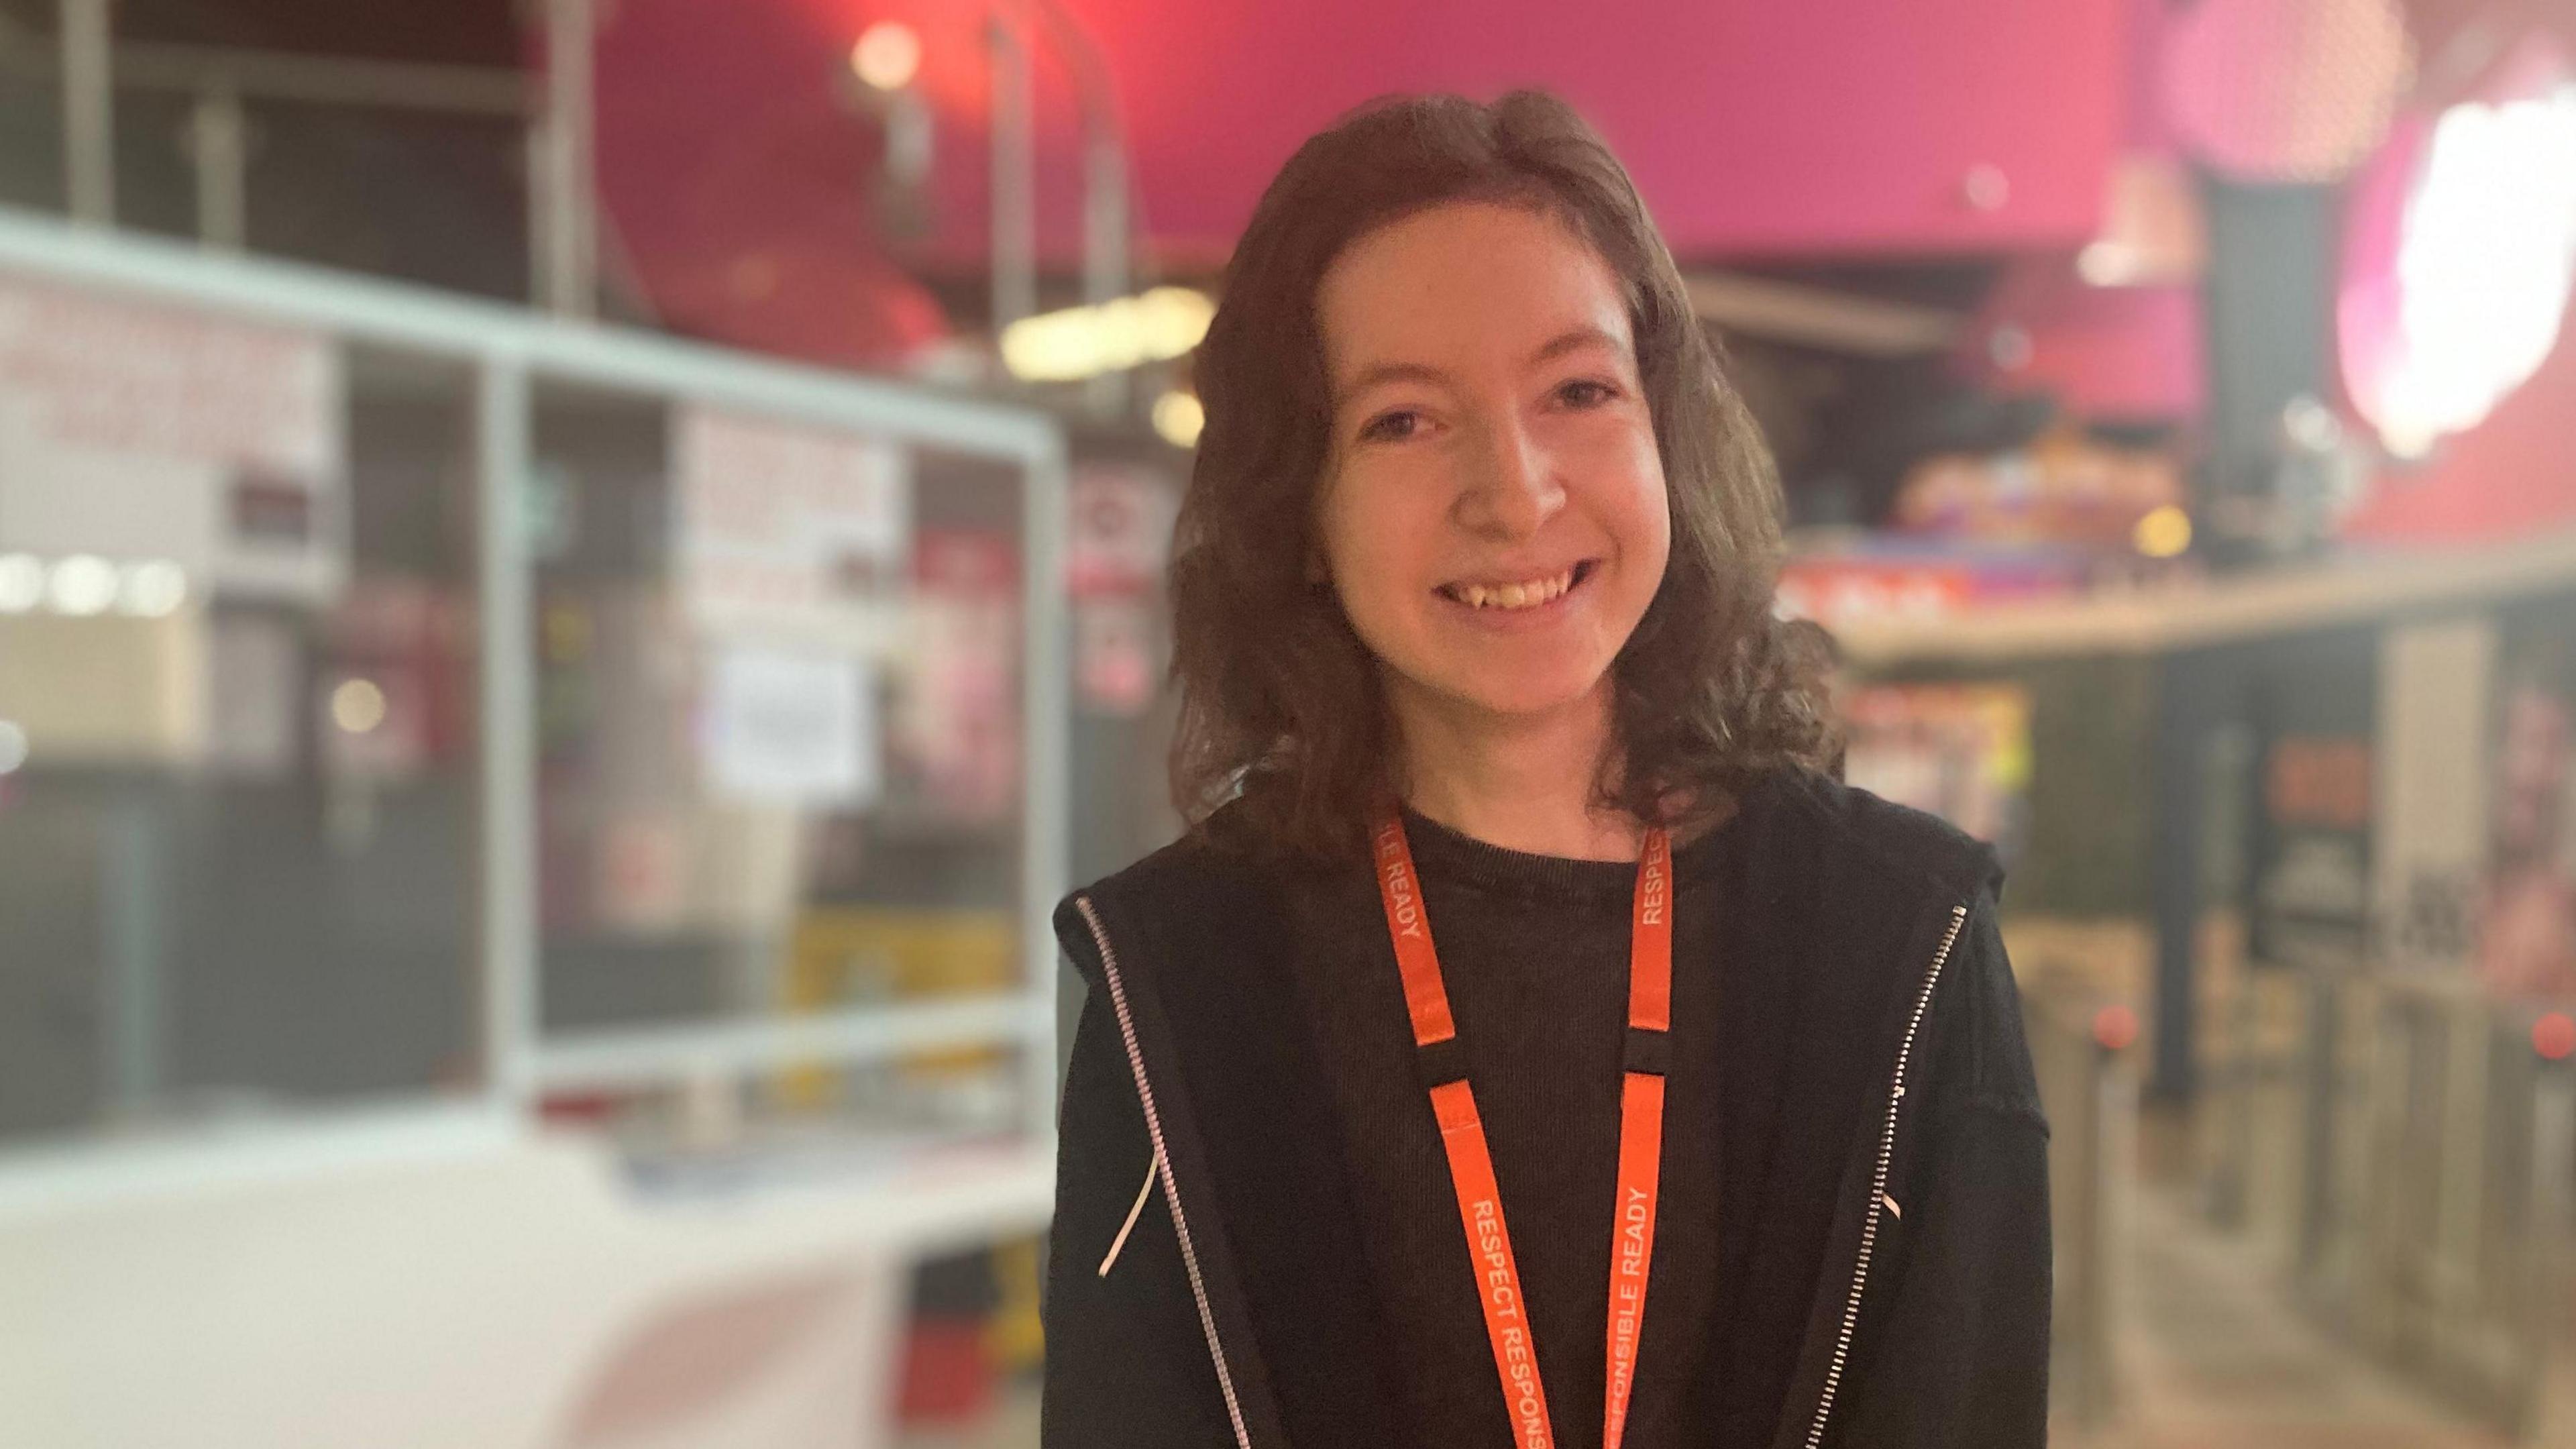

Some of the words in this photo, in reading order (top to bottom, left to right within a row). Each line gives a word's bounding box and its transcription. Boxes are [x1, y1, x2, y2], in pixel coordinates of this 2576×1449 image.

[1379, 824, 1401, 859] LE
[1642, 828, 1663, 924] RESPEC
[1387, 863, 1420, 936] READY
[1623, 1188, 1648, 1275] READY
[1474, 1200, 1516, 1318] RESPECT
[1503, 1328, 1546, 1449] RESPONS
